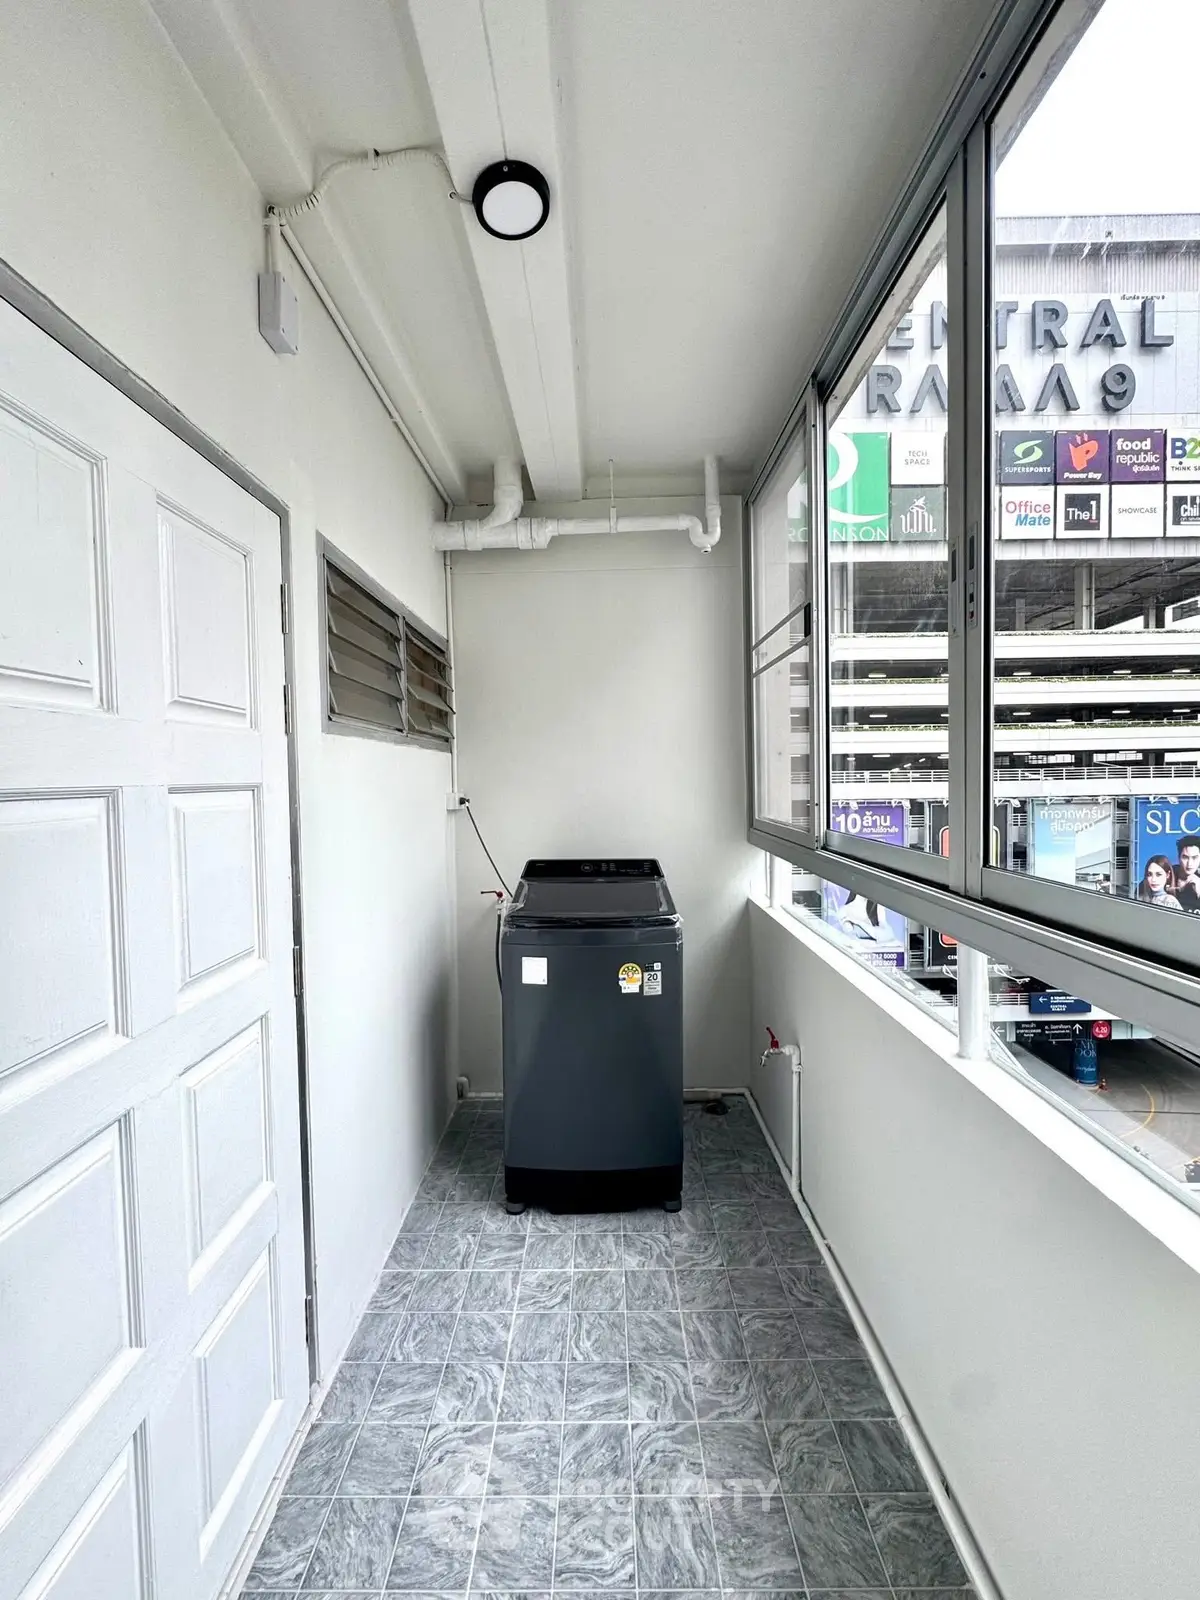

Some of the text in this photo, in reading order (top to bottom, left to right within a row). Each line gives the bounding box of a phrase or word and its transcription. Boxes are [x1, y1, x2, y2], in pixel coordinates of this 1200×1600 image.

[1116, 437, 1151, 451] food
[1170, 437, 1200, 459] B2
[1116, 452, 1160, 466] republic
[1005, 500, 1051, 514] Office
[1015, 513, 1051, 526] Mate
[788, 526, 889, 541] RONSON
[647, 972, 658, 981] 20
